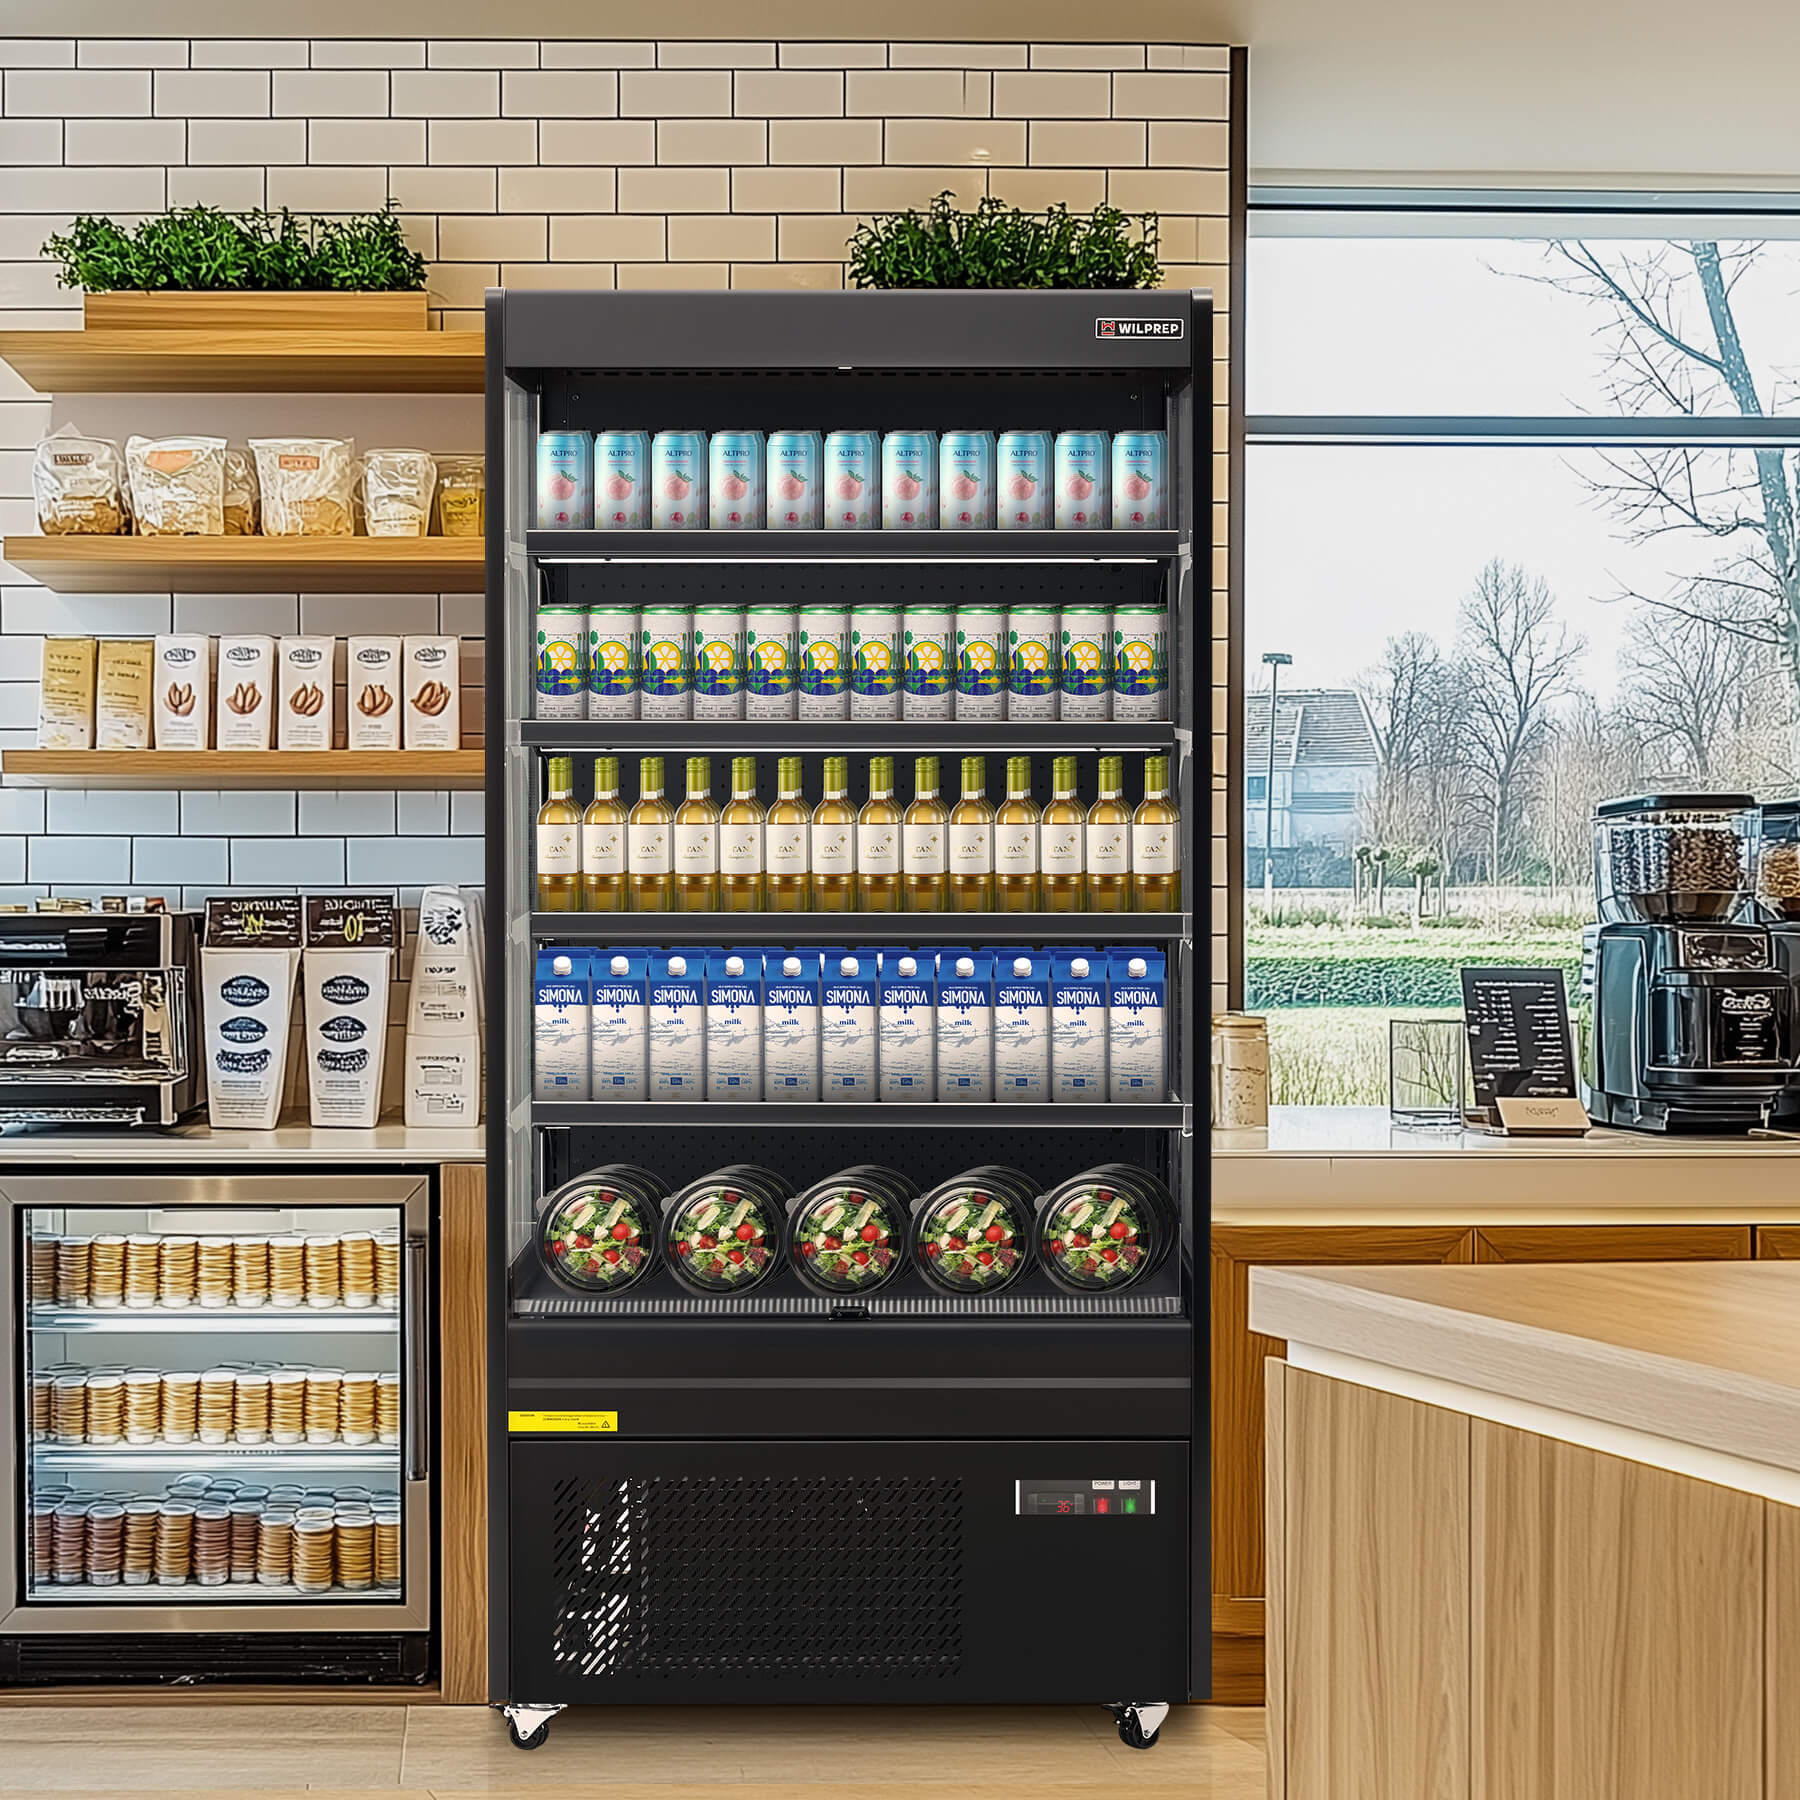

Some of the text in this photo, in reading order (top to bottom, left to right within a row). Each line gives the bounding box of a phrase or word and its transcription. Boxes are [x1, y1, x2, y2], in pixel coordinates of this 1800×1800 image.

[1118, 323, 1179, 334] WILPREP
[550, 449, 578, 457] ALTPRO
[607, 449, 635, 457] ALTPRO
[664, 449, 693, 457] ALTPRO
[722, 449, 750, 457] ALTPRO
[779, 449, 808, 457] ALTPRO
[837, 449, 865, 457] ALTPRO
[895, 449, 923, 457] ALTPRO
[952, 449, 981, 457] ALTPRO
[1010, 449, 1038, 457] ALTPRO
[1067, 449, 1095, 457] ALTPRO
[1125, 449, 1153, 457] ALTPRO
[539, 989, 583, 1003] SIMONA
[596, 989, 640, 1003] SIMONA
[654, 989, 698, 1003] SIMONA
[711, 989, 755, 1003] SIMONA
[769, 990, 813, 1004] SIMONA
[826, 990, 870, 1004] SIMONA
[884, 990, 928, 1004] SIMONA
[942, 990, 985, 1004] SIMONA
[999, 990, 1043, 1004] SIMONA
[1057, 991, 1100, 1005] SIMONA
[1114, 991, 1158, 1005] SIMONA
